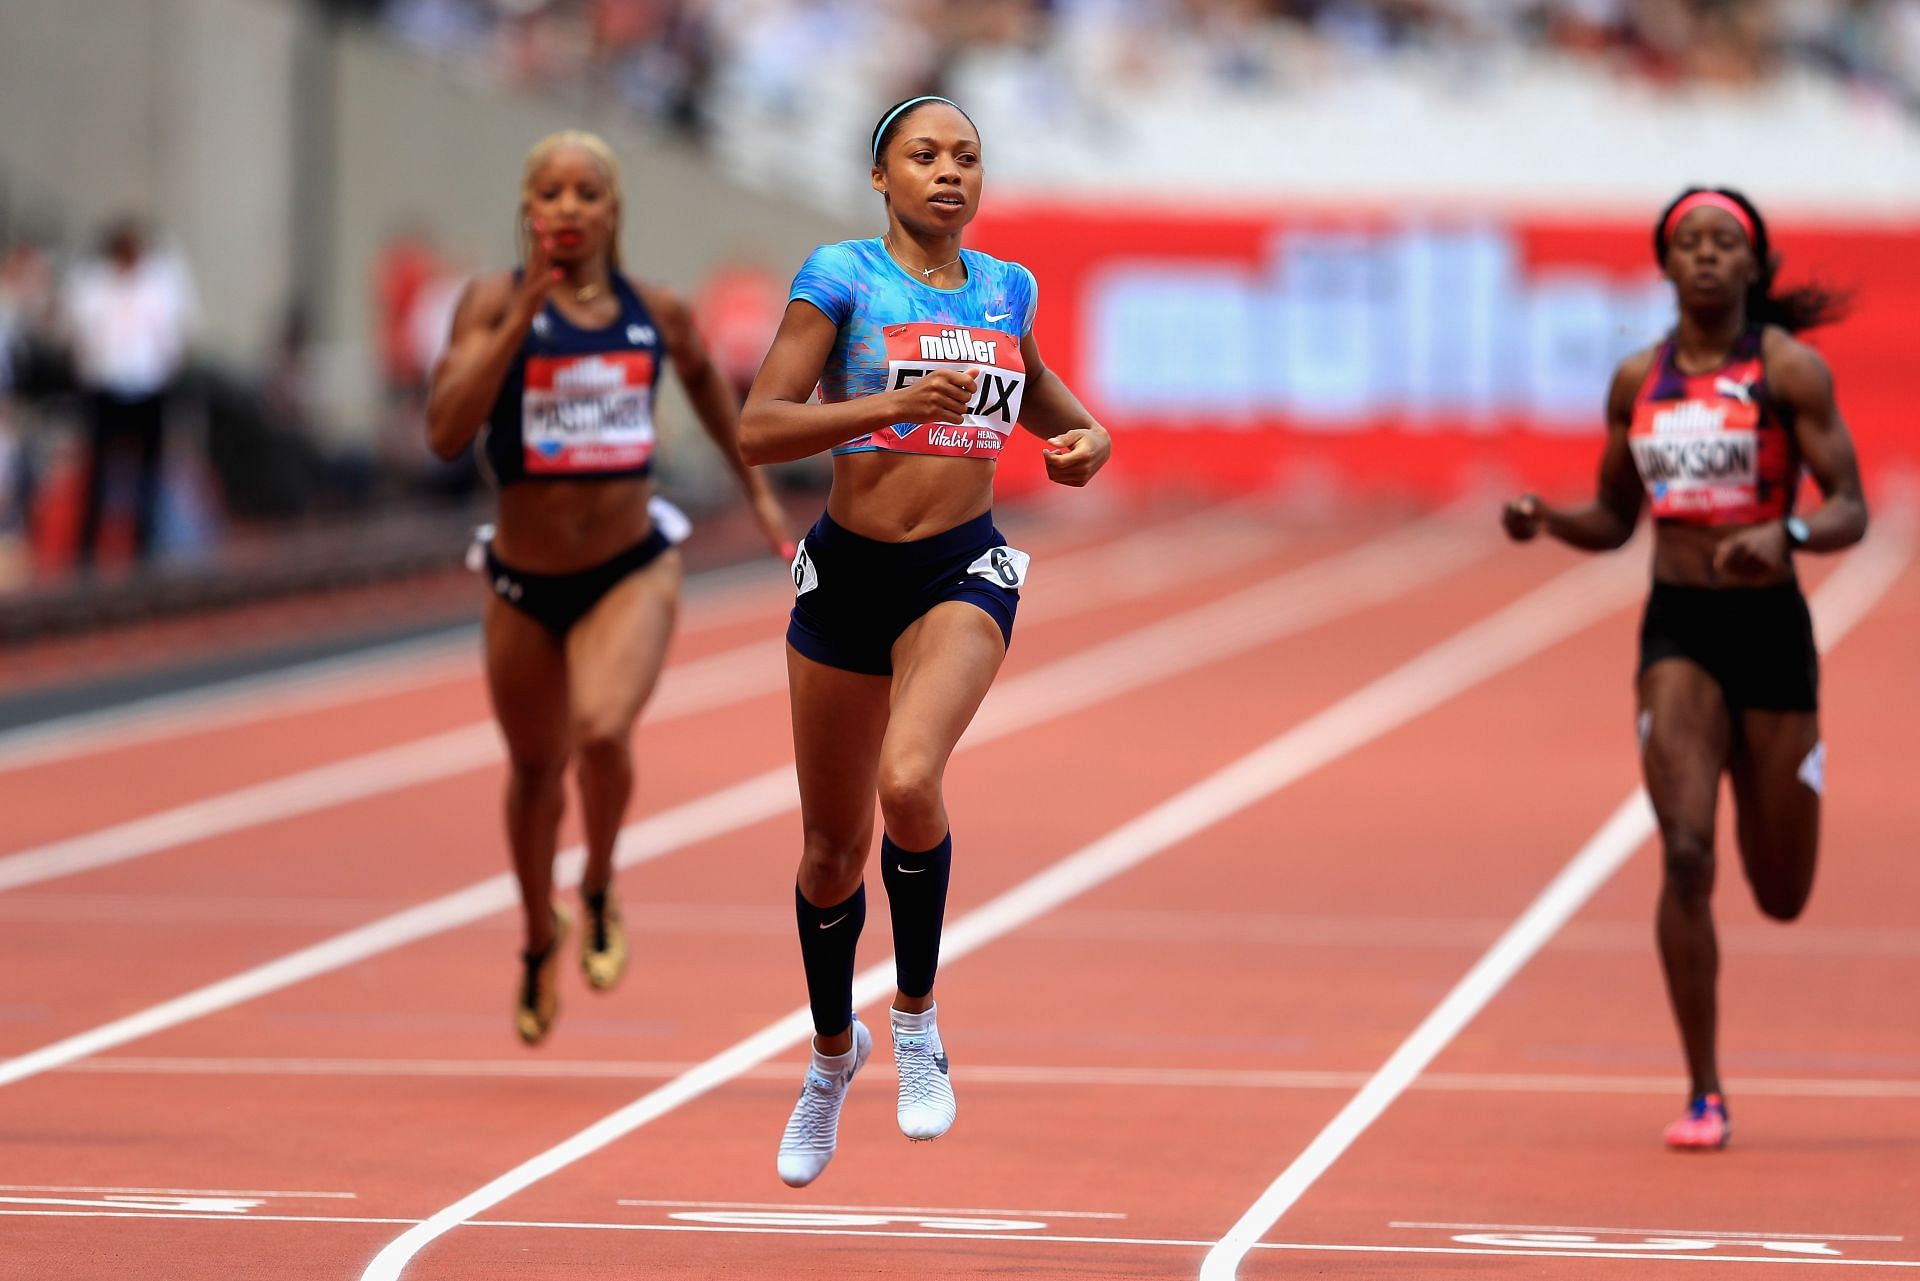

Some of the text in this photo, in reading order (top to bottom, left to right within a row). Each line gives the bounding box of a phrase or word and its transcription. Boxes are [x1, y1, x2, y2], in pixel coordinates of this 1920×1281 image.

[919, 329, 997, 365] müller
[893, 368, 1020, 424] FIX
[928, 425, 974, 454] Vitality
[976, 440, 1002, 450] INSUR
[991, 548, 1019, 586] 6
